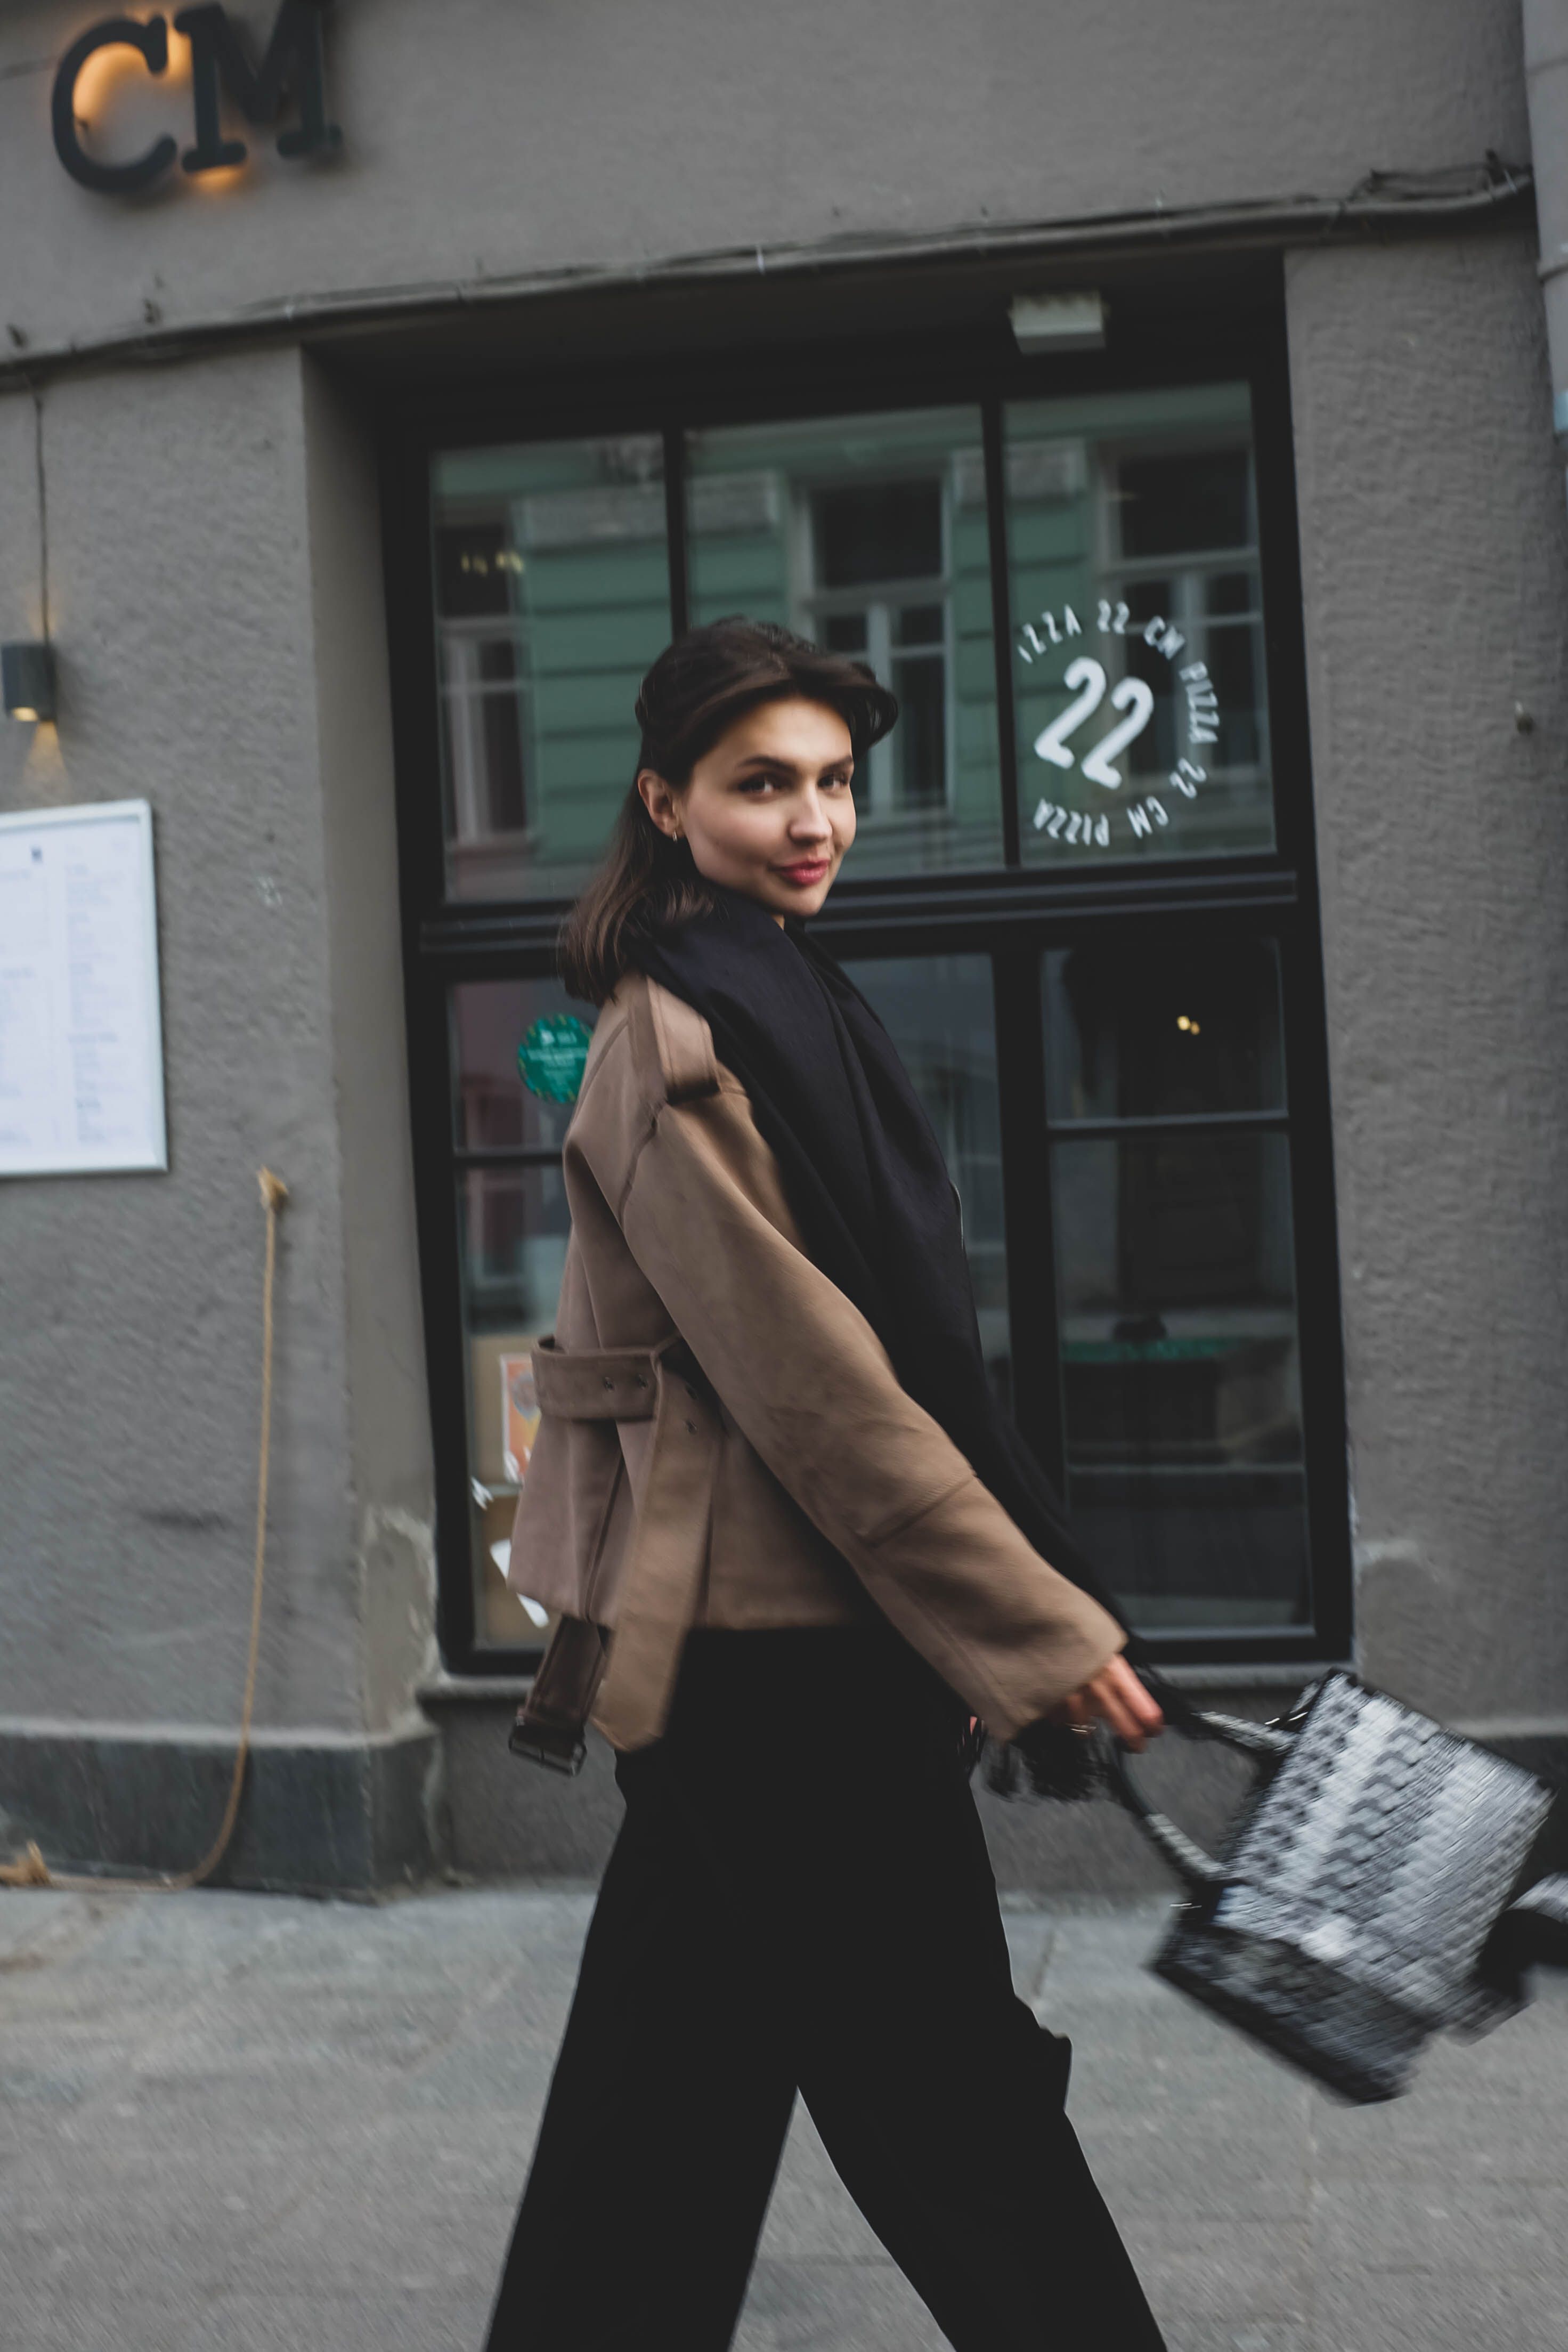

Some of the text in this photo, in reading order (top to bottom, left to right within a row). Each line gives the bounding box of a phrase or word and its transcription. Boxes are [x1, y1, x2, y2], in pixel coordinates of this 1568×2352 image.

[52, 0, 342, 193] CM
[1017, 603, 1082, 664] IZZA
[1096, 598, 1130, 634] 22
[1034, 656, 1155, 790] 22
[1179, 661, 1221, 745] PIZZA
[1168, 758, 1207, 799] 22
[1033, 798, 1110, 847] PIZZA
[1126, 796, 1169, 838] CM
